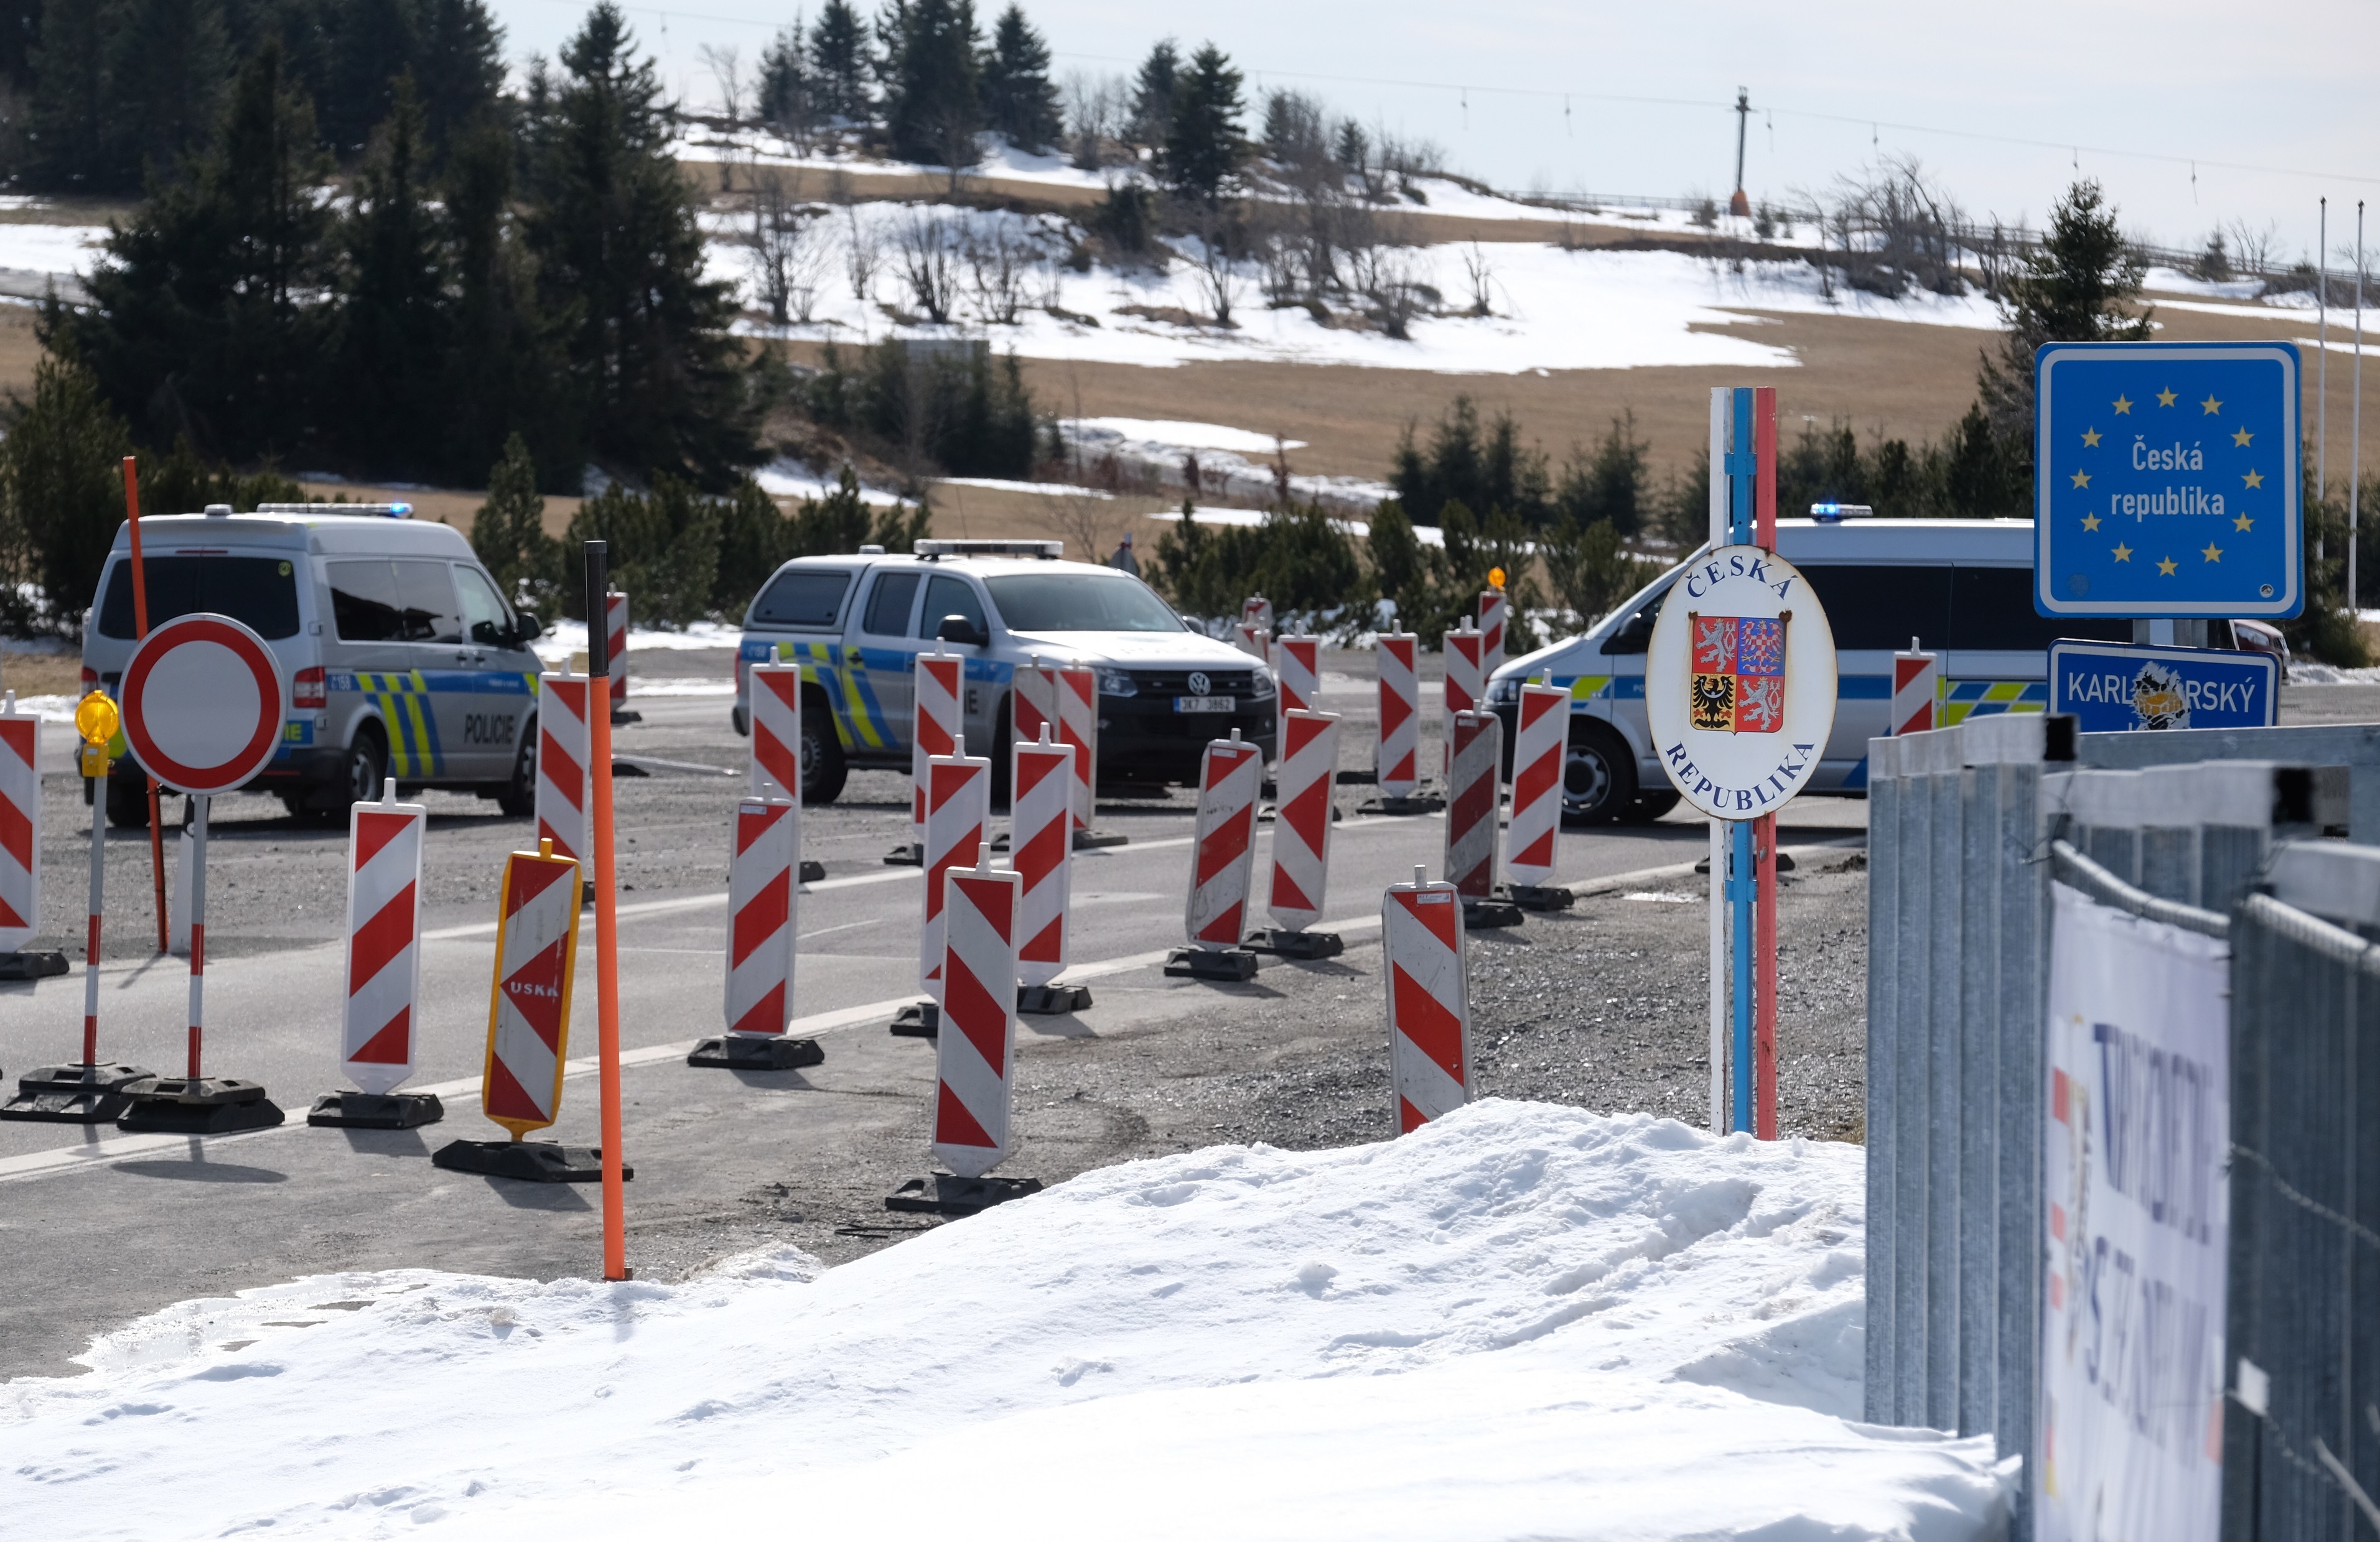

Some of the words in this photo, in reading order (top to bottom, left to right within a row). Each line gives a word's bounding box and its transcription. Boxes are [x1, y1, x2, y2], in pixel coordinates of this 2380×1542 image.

[2132, 434, 2203, 470] Česká
[2111, 486, 2225, 523] republika
[1685, 555, 1798, 600] ČESKÁ
[2068, 672, 2256, 713] KARLRSKÝ
[464, 714, 515, 745] POLICIE
[1666, 740, 1815, 810] REPUBLIKA
